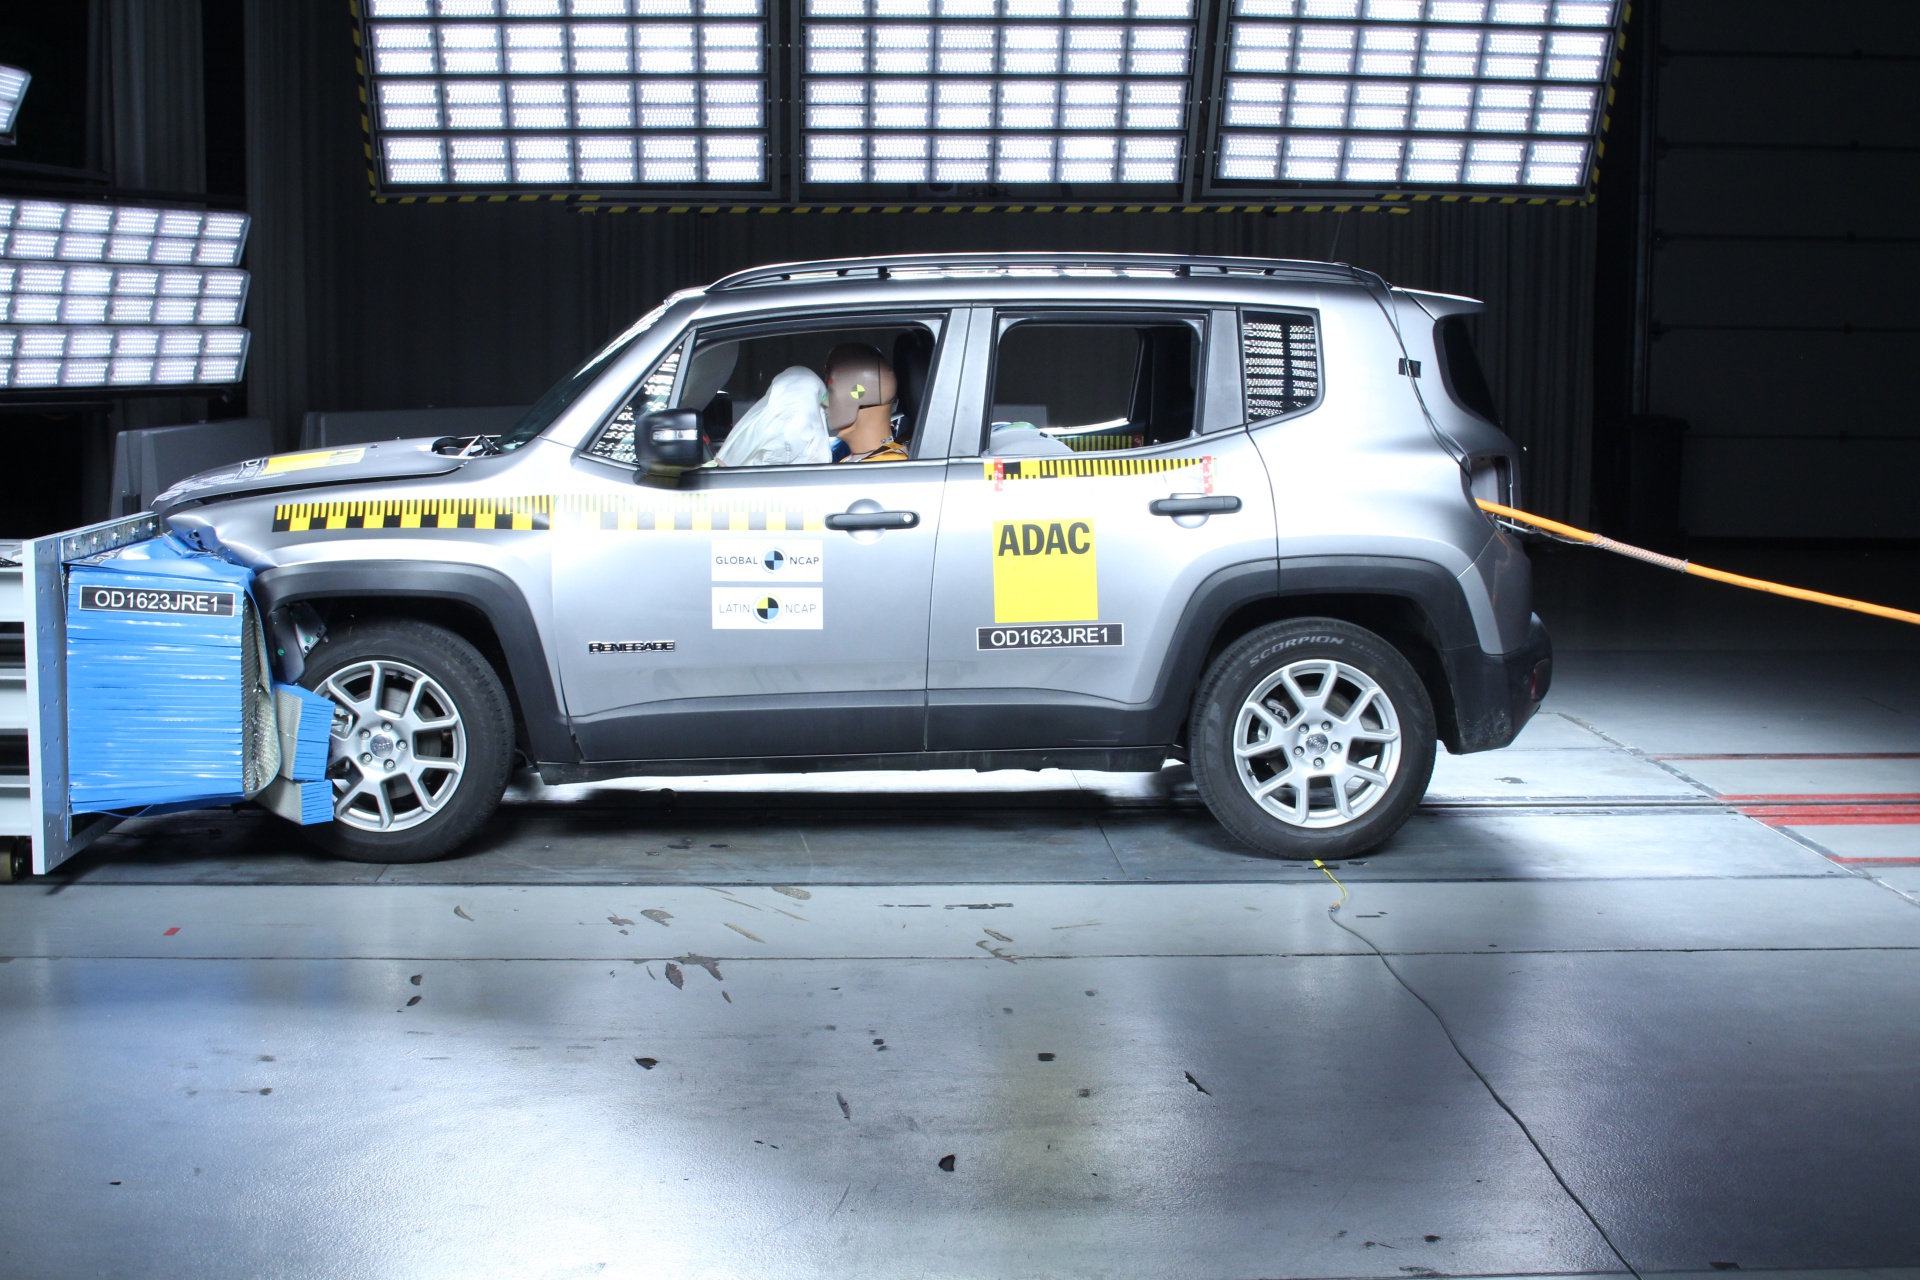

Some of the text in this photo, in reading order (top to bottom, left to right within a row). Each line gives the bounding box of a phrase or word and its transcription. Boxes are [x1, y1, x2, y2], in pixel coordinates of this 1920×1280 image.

[998, 522, 1091, 556] ADAC
[715, 556, 820, 565] GLOBAL NCAP
[94, 590, 218, 612] OD1623JRE1
[719, 603, 817, 613] LATIN NCAP
[990, 627, 1108, 646] OD1623JRE1
[588, 640, 675, 654] RENEGADE
[1249, 635, 1345, 667] SCORPION
